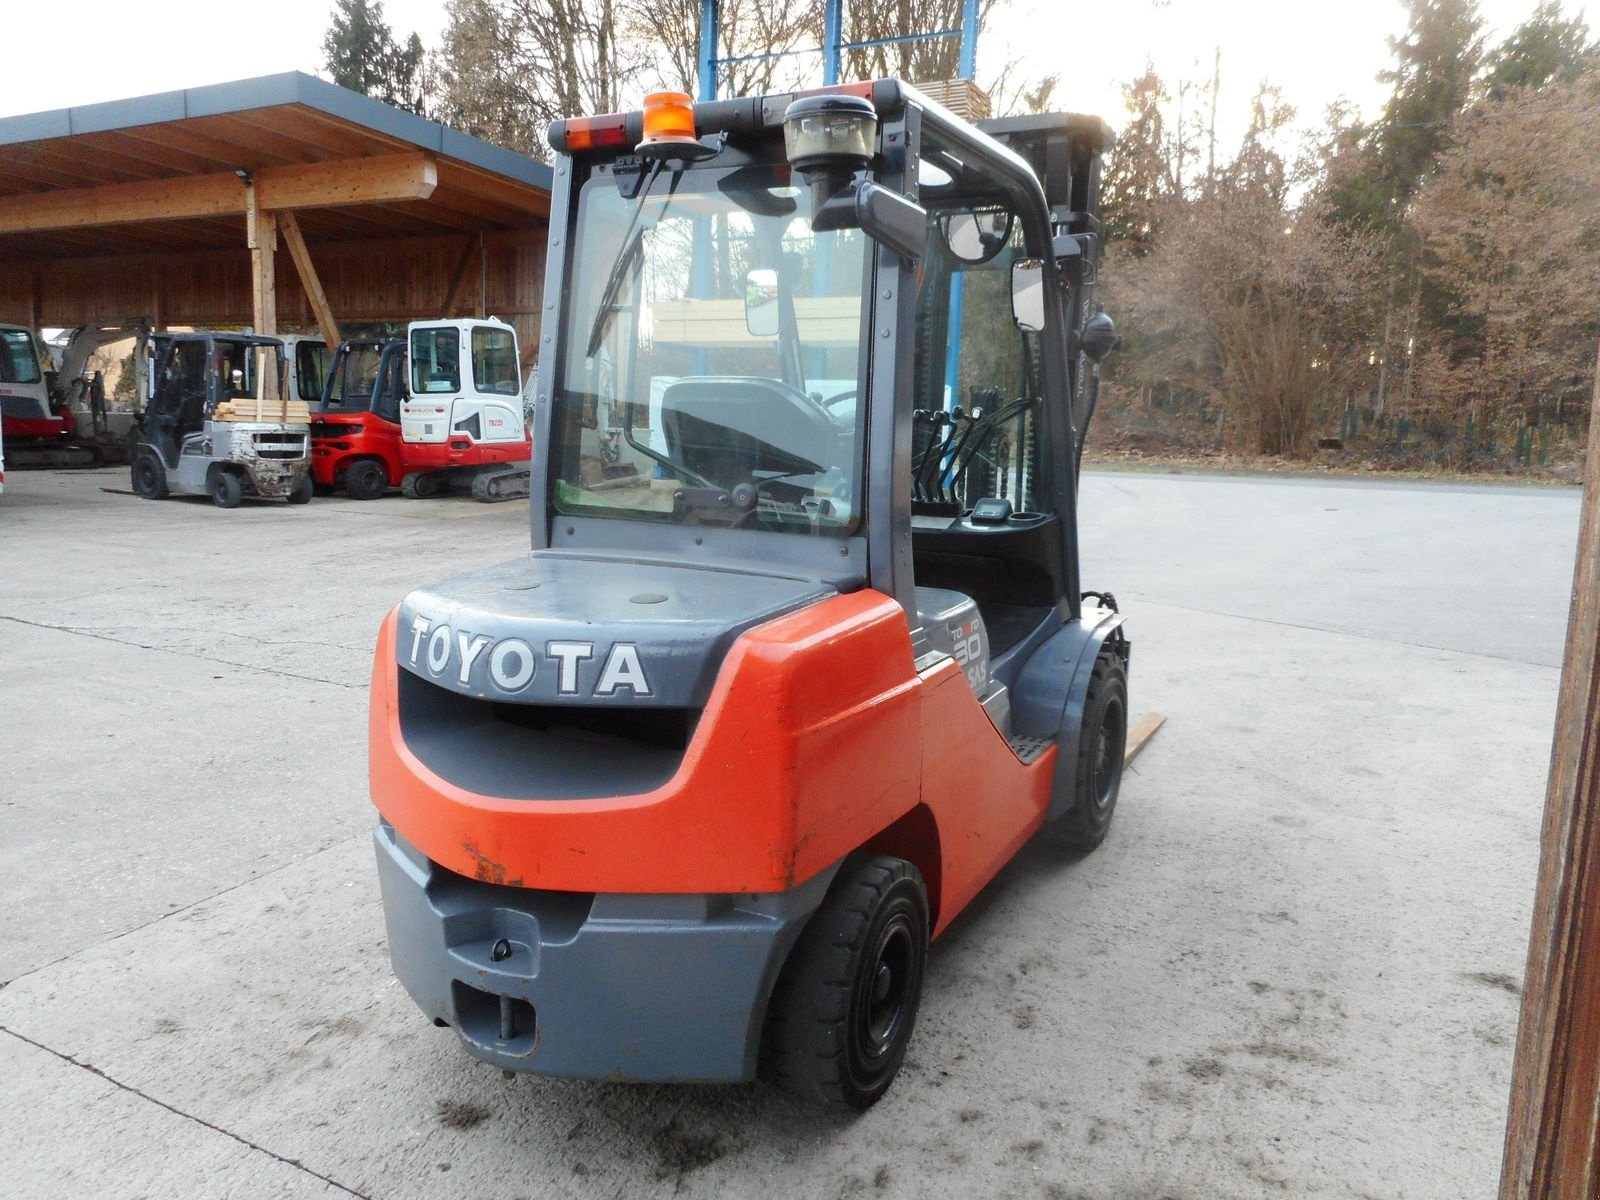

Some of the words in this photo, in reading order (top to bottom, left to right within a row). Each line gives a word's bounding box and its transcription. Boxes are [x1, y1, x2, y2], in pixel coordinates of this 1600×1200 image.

[410, 614, 652, 696] TOYOTA
[954, 633, 981, 667] 30
[968, 660, 986, 688] SAS
